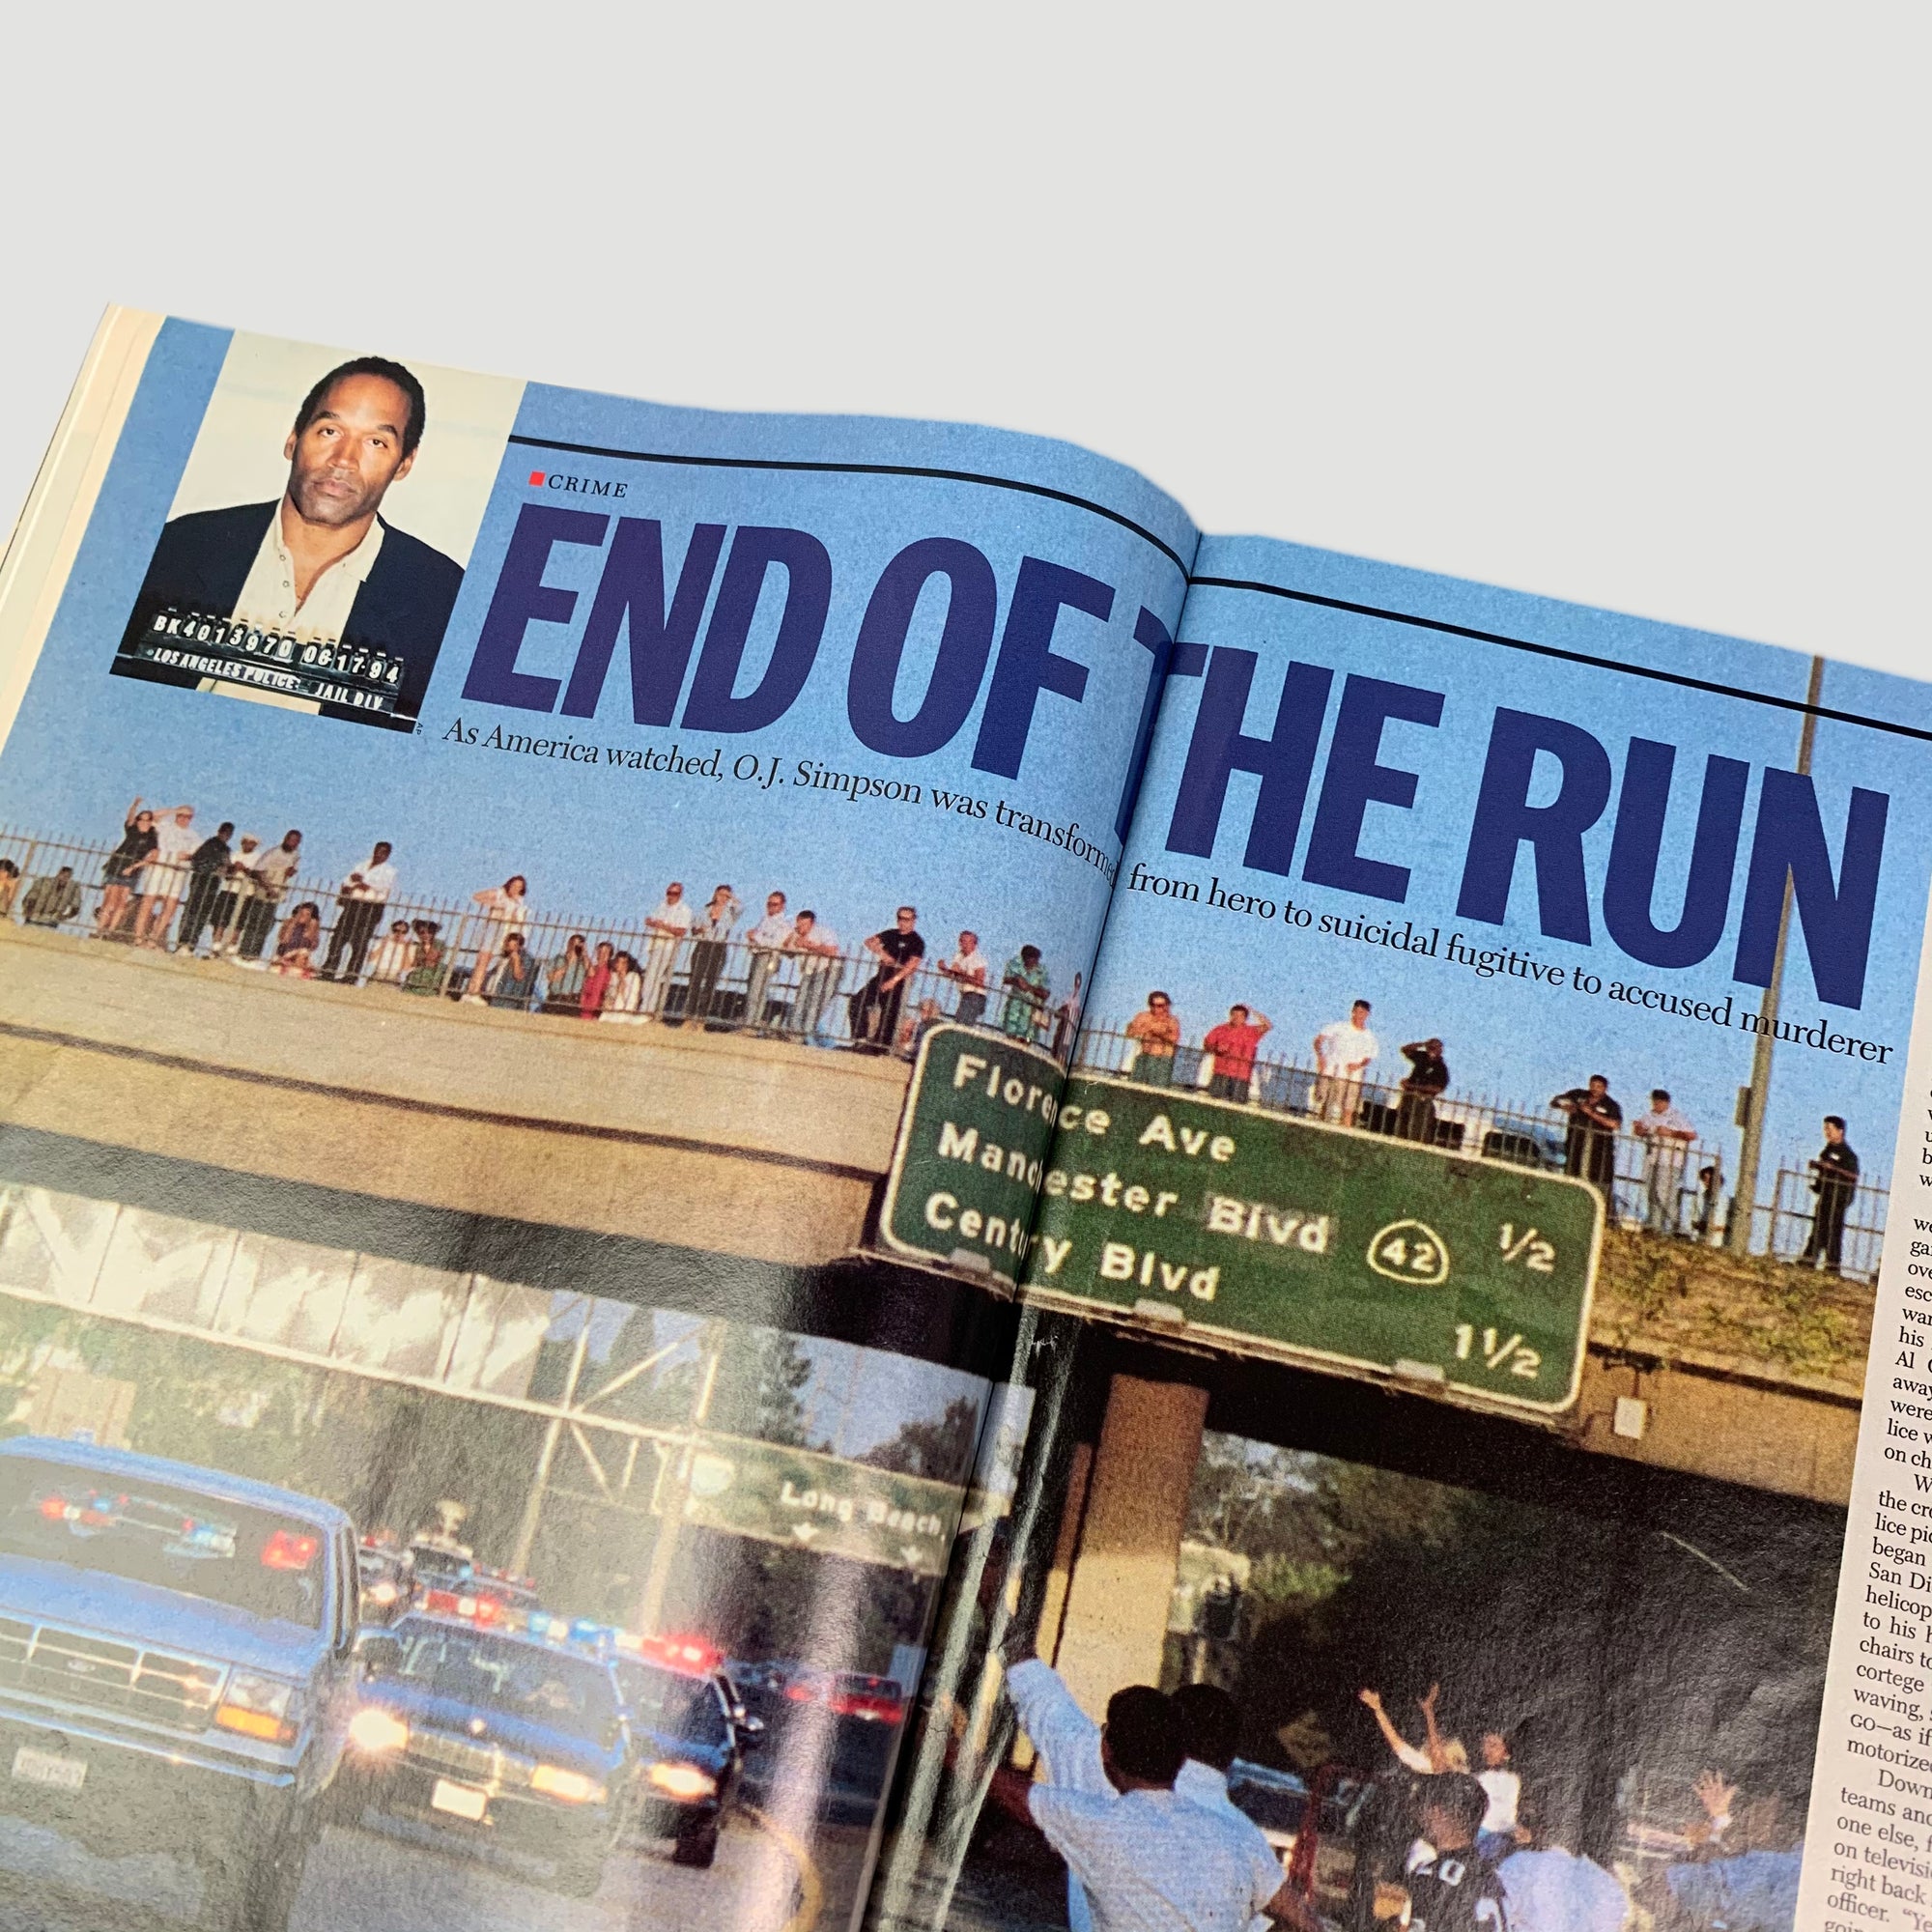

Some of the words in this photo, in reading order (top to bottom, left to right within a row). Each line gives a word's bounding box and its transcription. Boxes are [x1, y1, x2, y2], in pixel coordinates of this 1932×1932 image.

[547, 473, 629, 498] CRIME
[154, 647, 181, 665] LOS
[179, 653, 242, 678] ANGELES
[314, 682, 350, 703] JAIL
[353, 691, 384, 711] DIV
[461, 502, 833, 733] END
[846, 536, 1117, 781] OF
[1114, 605, 1446, 903] THE
[1455, 706, 1890, 1010] RUN
[441, 717, 479, 745] As
[481, 724, 599, 764] America
[606, 744, 724, 783] watched,
[732, 754, 785, 790] O.J.
[792, 759, 923, 806] Simpson
[930, 786, 988, 819] was
[1126, 862, 1200, 902] from
[1207, 877, 1277, 920] hero
[1283, 899, 1313, 928] to
[1318, 914, 1438, 957] suicidal
[1445, 931, 1566, 987] fugitive
[1572, 963, 1603, 995] to
[1608, 979, 1734, 1028] accused
[1739, 1010, 1894, 1065] murderer
[1139, 1115, 1236, 1162] Ave
[1208, 1195, 1330, 1254] Blvd
[1380, 1237, 1435, 1273] 42
[1099, 1241, 1221, 1302] Blvd
[1898, 1324, 1925, 1349] his
[1894, 1350, 1916, 1369] Al
[1886, 1416, 1919, 1442] lice
[1884, 1445, 1908, 1464] on
[780, 1481, 853, 1522] Long
[1878, 1490, 1908, 1512] the
[1874, 1512, 1907, 1537] lice
[1872, 1536, 1926, 1567] began
[1869, 1561, 1902, 1586] San
[1862, 1611, 1881, 1630] to
[1889, 1615, 1917, 1639] his
[1860, 1635, 1915, 1664] chairs
[1856, 1663, 1925, 1694] cortege
[1853, 1688, 1924, 1721] waving,
[1846, 1738, 1932, 1773] motorize
[1840, 1786, 1896, 1816] teams
[1836, 1816, 1872, 1836] one
[1877, 1823, 1919, 1853] else,
[1833, 1841, 1858, 1861] on
[1863, 1846, 1932, 1880] televisi
[1830, 1864, 1877, 1891] right
[1881, 1874, 1928, 1906] back
[1827, 1890, 1890, 1922] officer.
